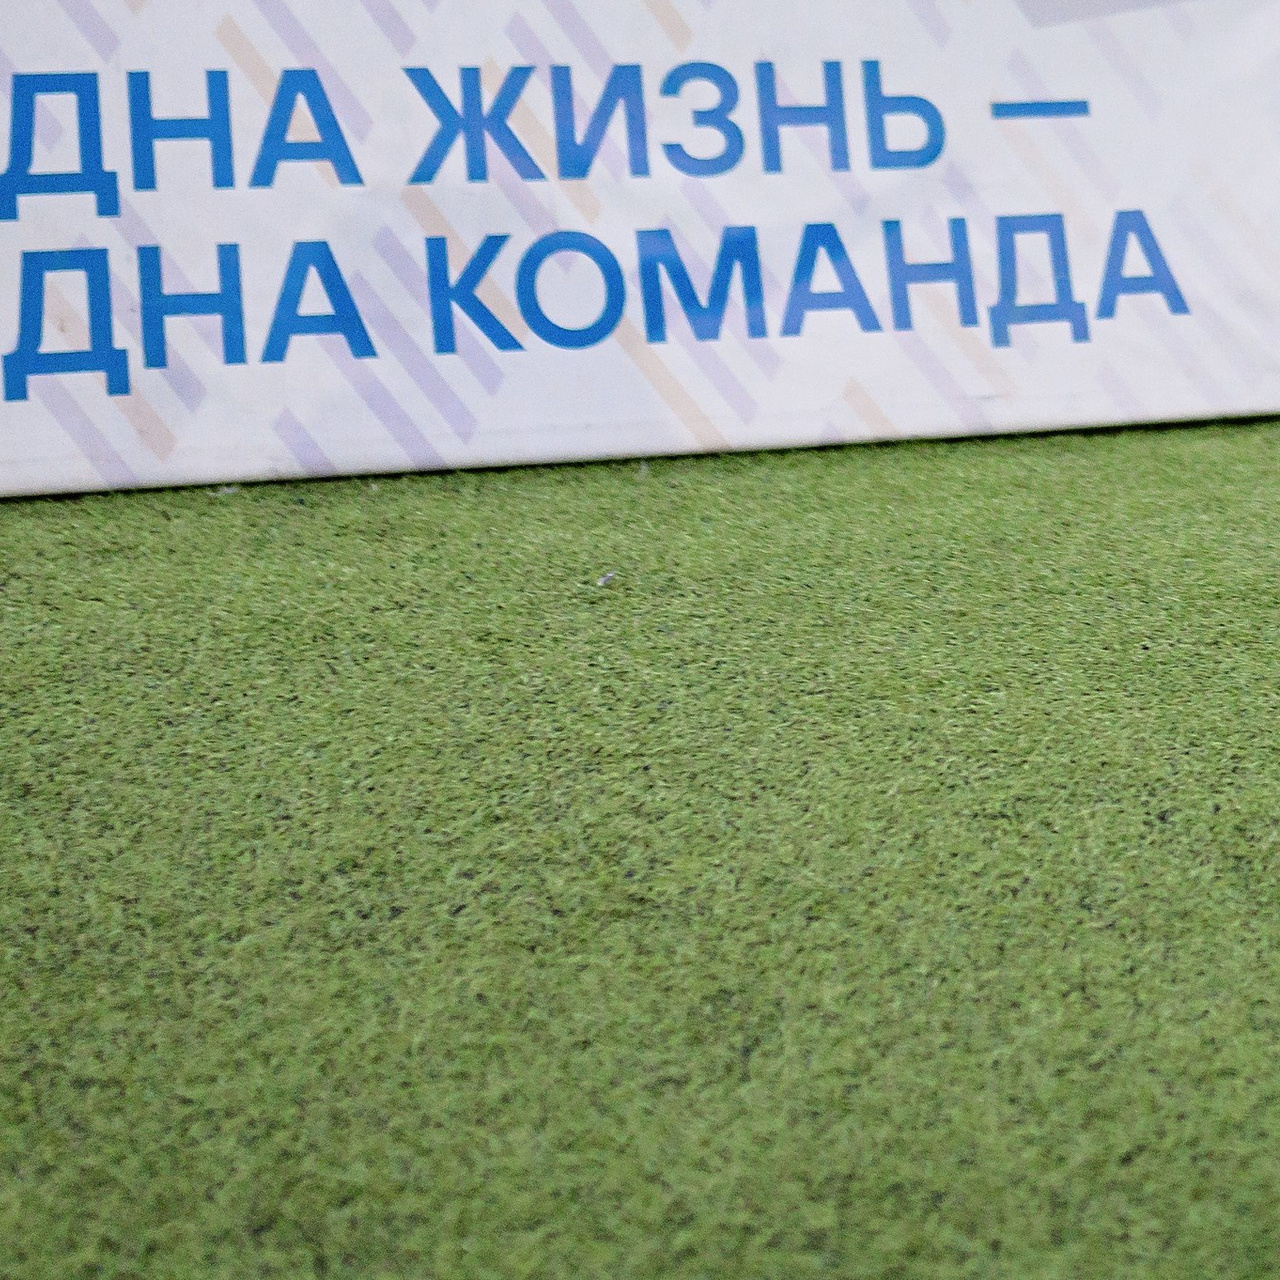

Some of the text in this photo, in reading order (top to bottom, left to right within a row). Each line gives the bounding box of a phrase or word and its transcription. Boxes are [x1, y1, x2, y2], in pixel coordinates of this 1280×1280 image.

[0, 69, 365, 220] ДНА
[402, 59, 947, 186] ЖИЗНЬ
[2, 209, 1192, 402] ДНА КОМАНДА
